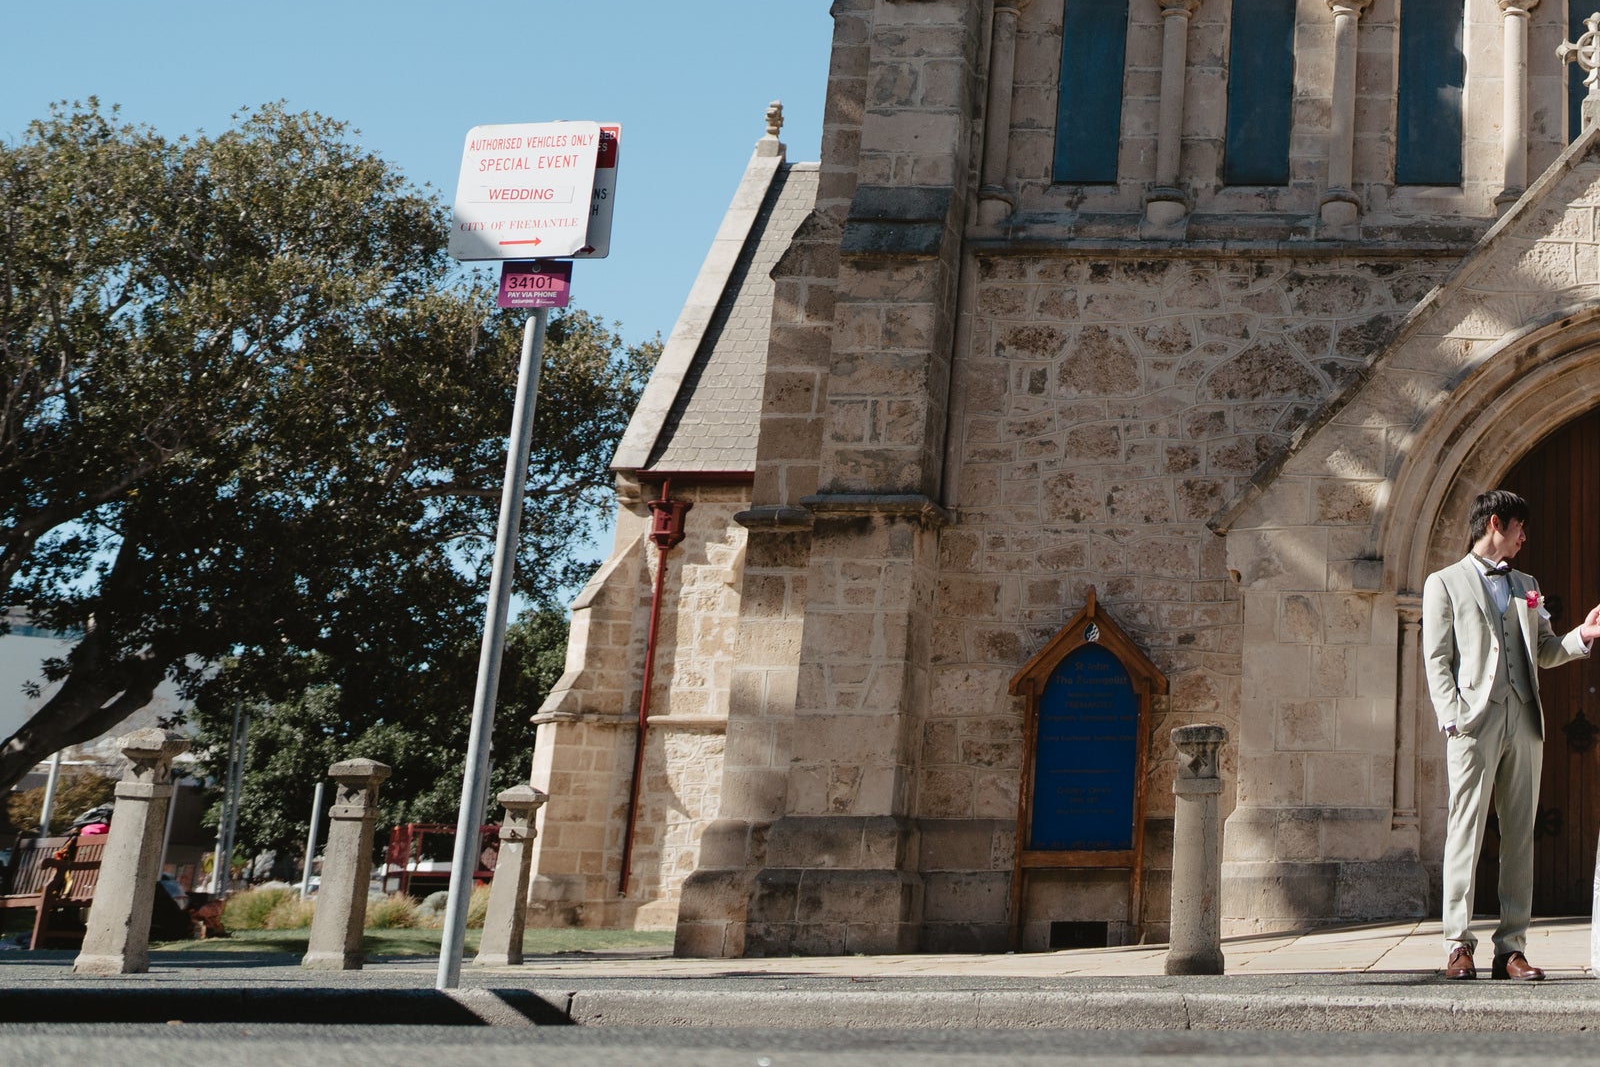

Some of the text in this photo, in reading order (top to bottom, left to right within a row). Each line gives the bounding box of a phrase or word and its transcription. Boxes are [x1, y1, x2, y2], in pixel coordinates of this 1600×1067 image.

[469, 137, 523, 152] AUTHORISED
[526, 135, 567, 149] VEHICLES
[570, 133, 595, 147] ONLY
[479, 154, 580, 172] SPECIAL EVENT
[488, 188, 555, 200] WEDDING
[460, 217, 579, 232] CITY OF FREMANTLE
[508, 276, 553, 289] 34101
